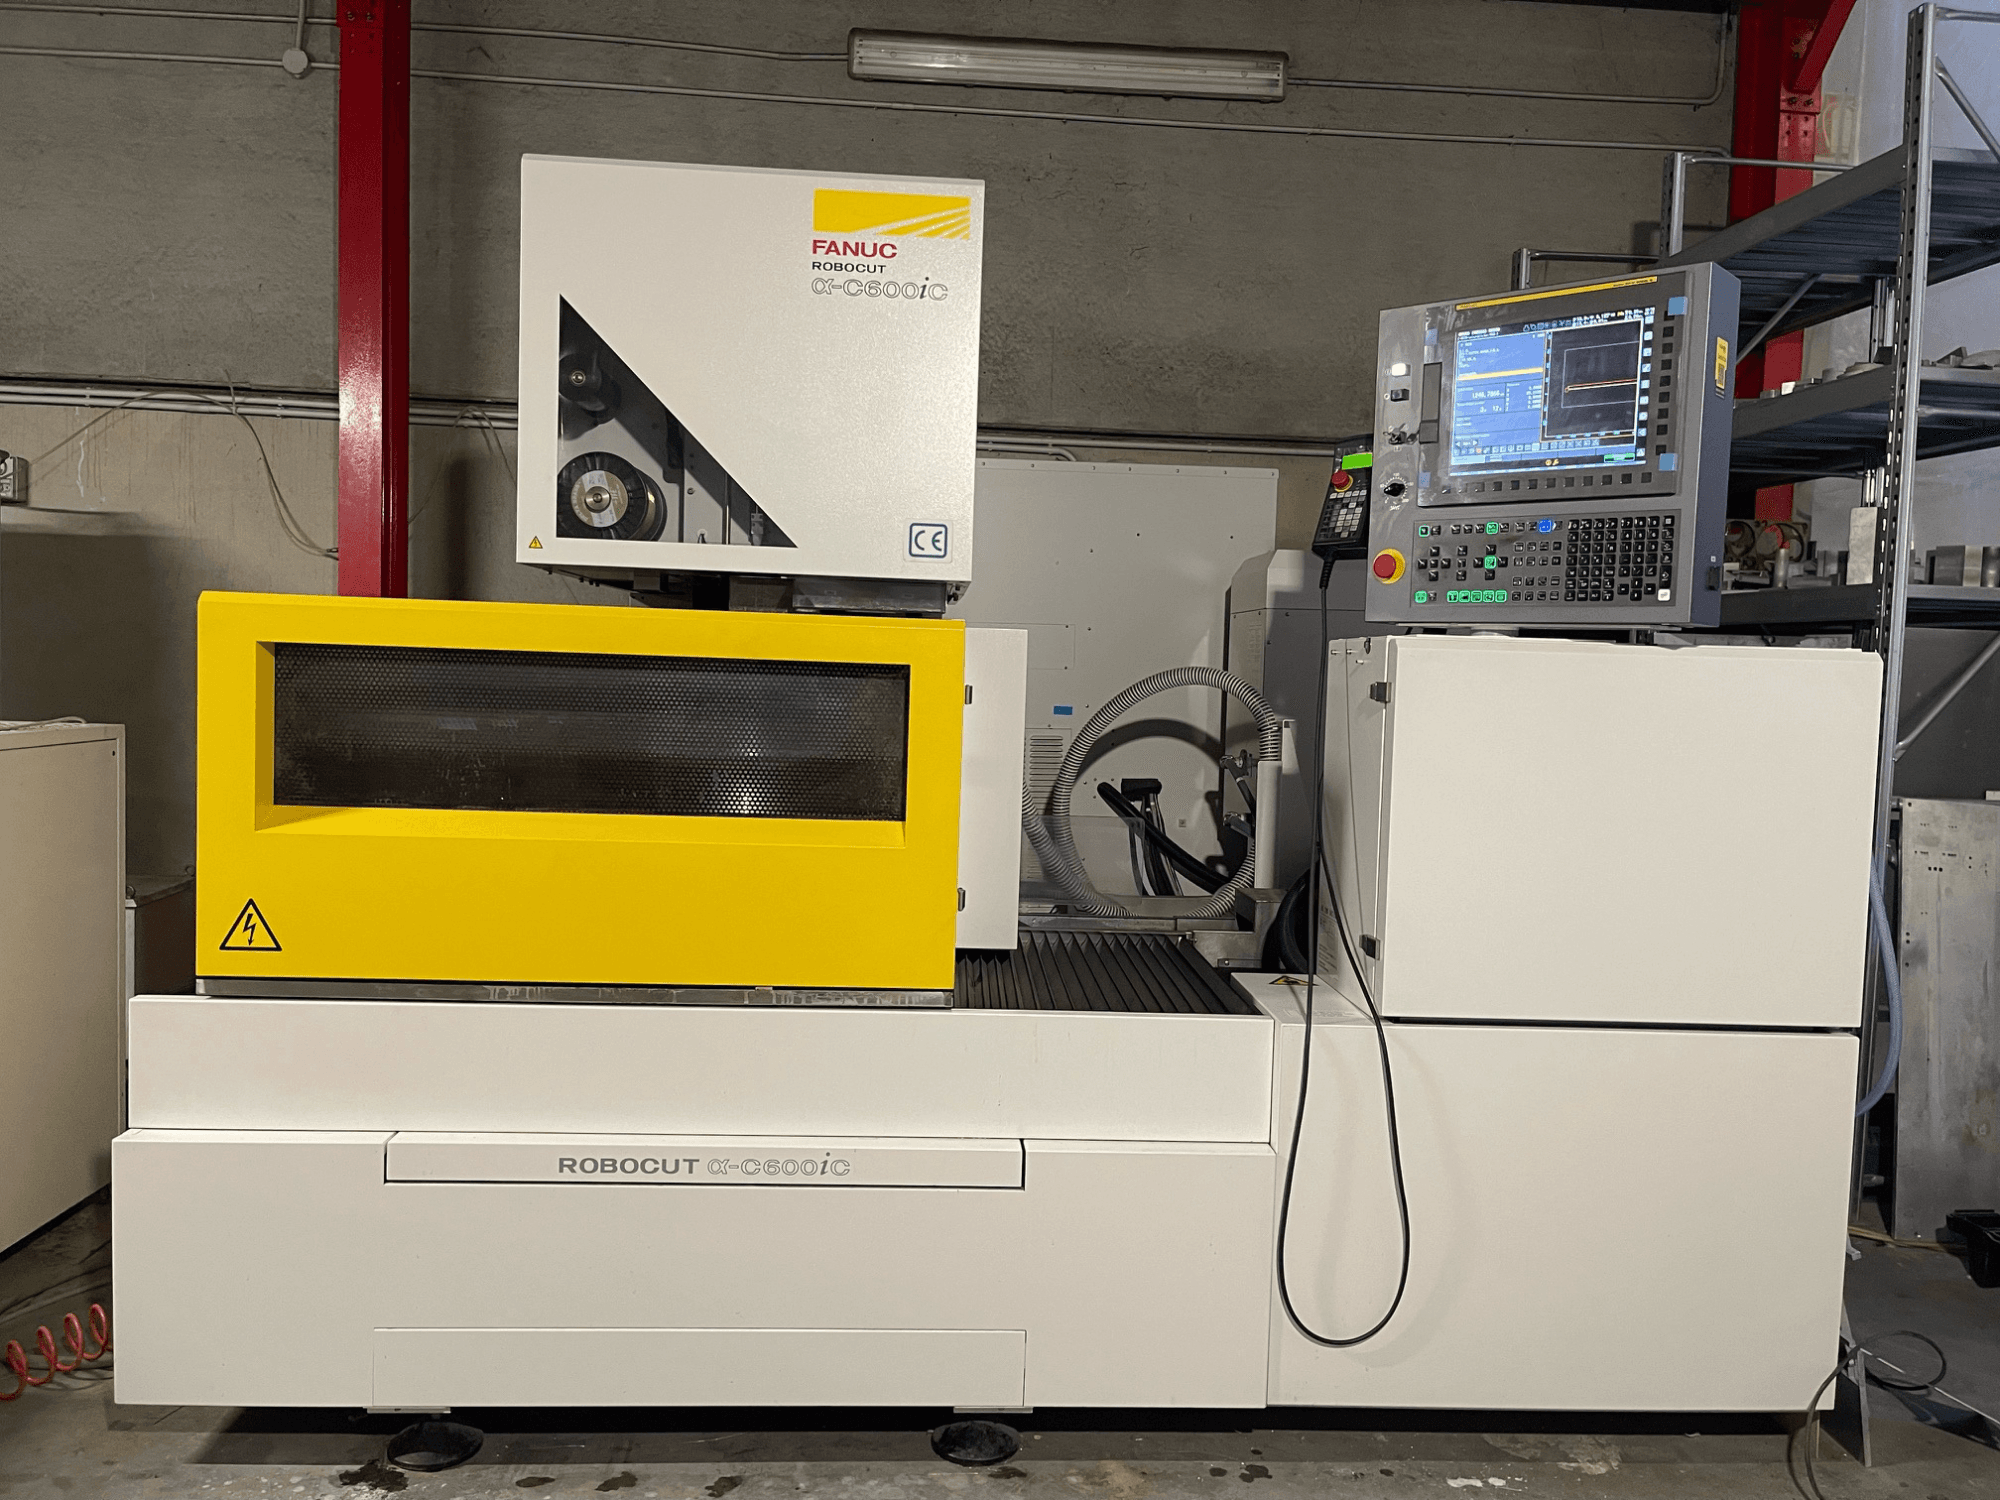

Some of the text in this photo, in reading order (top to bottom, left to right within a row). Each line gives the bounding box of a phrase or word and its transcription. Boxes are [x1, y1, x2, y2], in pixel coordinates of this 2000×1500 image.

[812, 239, 898, 259] FANUC
[811, 261, 887, 274] ROBOCUT
[914, 530, 943, 551] CE
[558, 1157, 700, 1175] ROBOCUT
